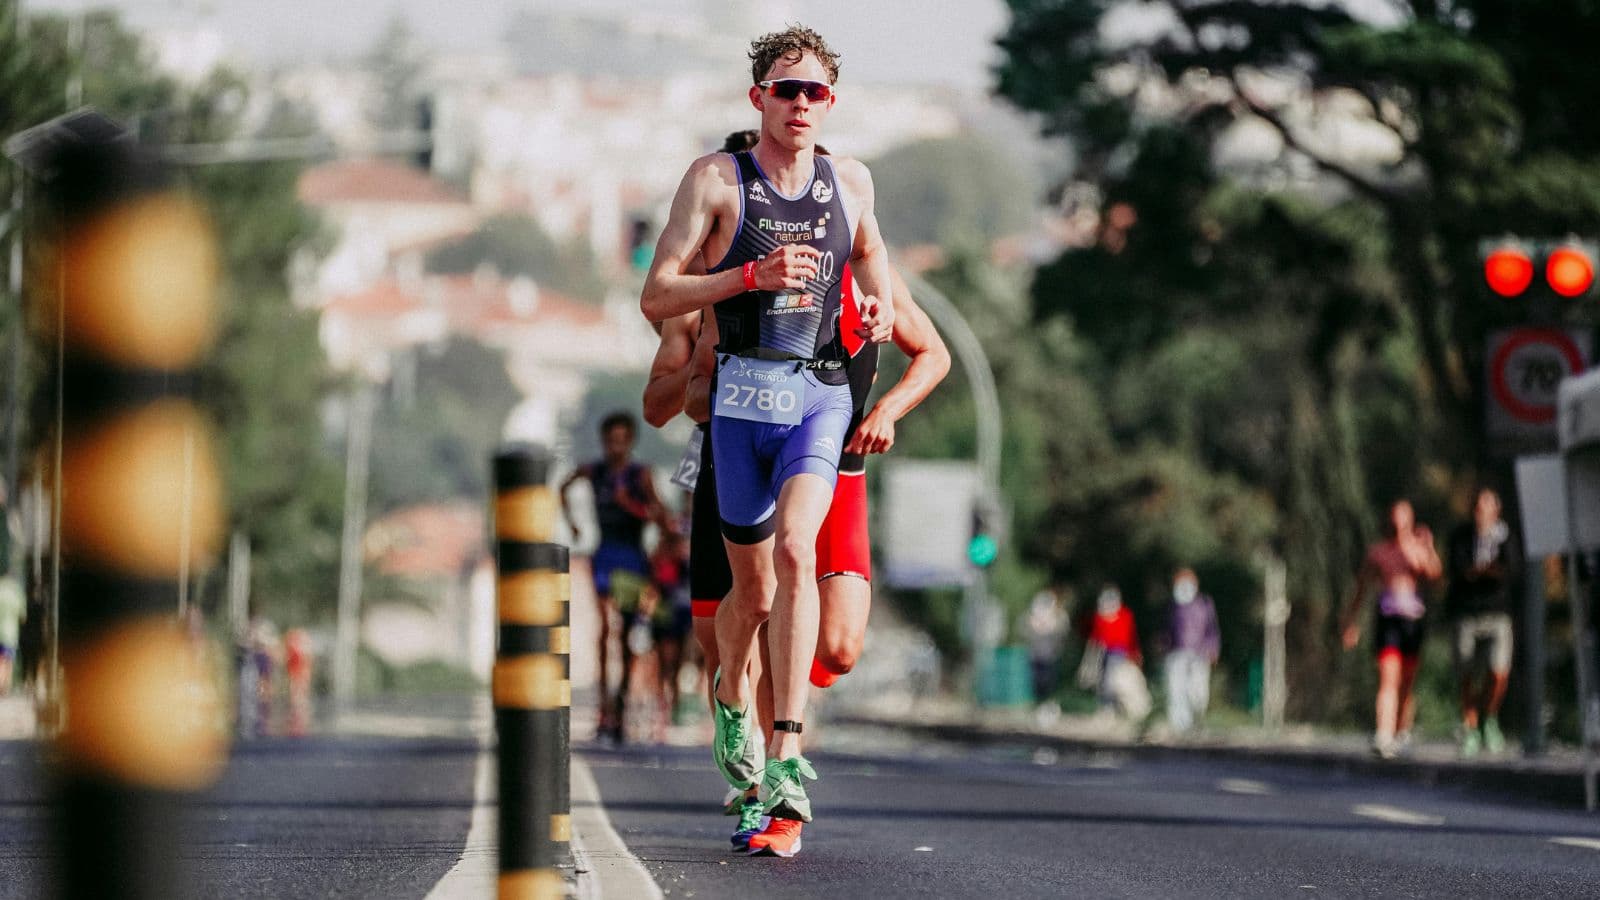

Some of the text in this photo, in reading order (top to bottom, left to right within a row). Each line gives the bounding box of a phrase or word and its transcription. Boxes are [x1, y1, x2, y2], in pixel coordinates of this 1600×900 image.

[759, 218, 811, 232] FILSTONE
[775, 231, 813, 241] natural
[723, 383, 796, 413] 2780
